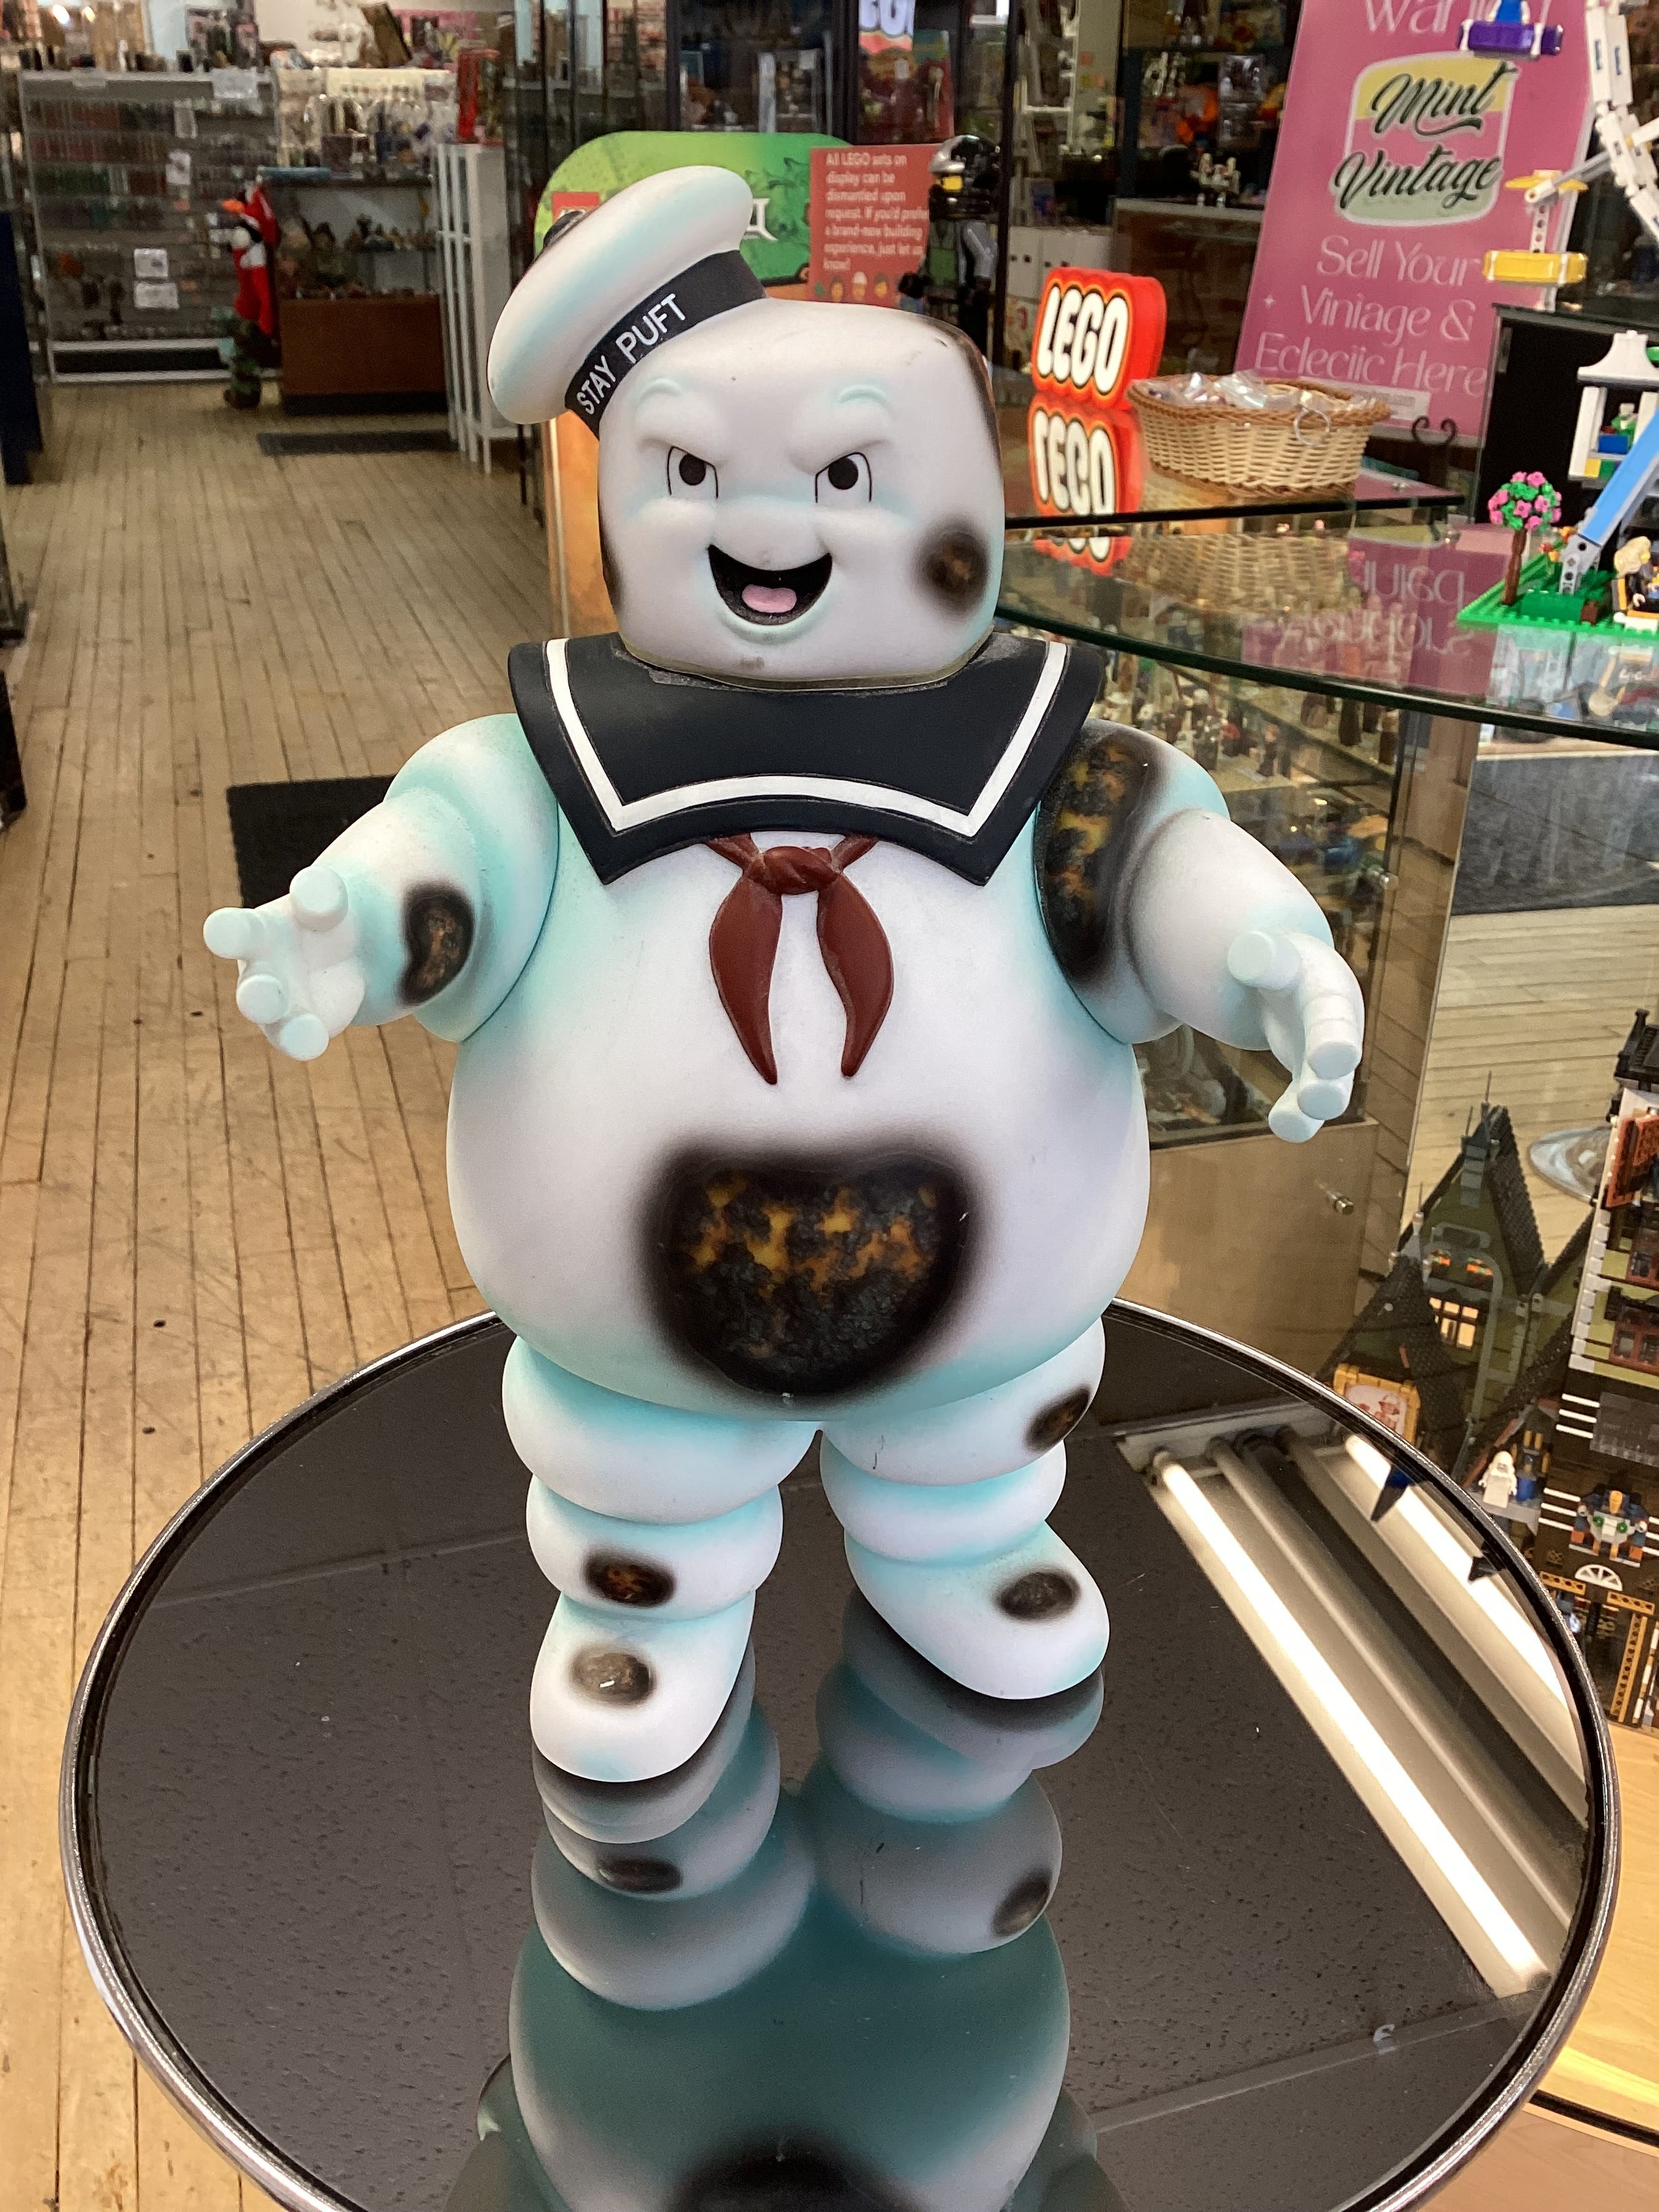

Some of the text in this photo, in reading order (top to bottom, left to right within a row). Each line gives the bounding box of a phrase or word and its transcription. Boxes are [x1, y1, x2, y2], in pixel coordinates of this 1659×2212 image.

[1370, 60, 1518, 136] Mint
[841, 152, 871, 167] LEGO
[894, 155, 907, 165] on
[861, 173, 880, 184] can
[883, 171, 895, 184] be
[1334, 143, 1500, 209] Vintage
[1317, 235, 1481, 286] Sell Your
[1038, 285, 1129, 393] LEGO
[1300, 285, 1476, 346] Vintage &
[577, 293, 686, 415] STAY PUFT
[1254, 332, 1488, 396] Eclectic Here
